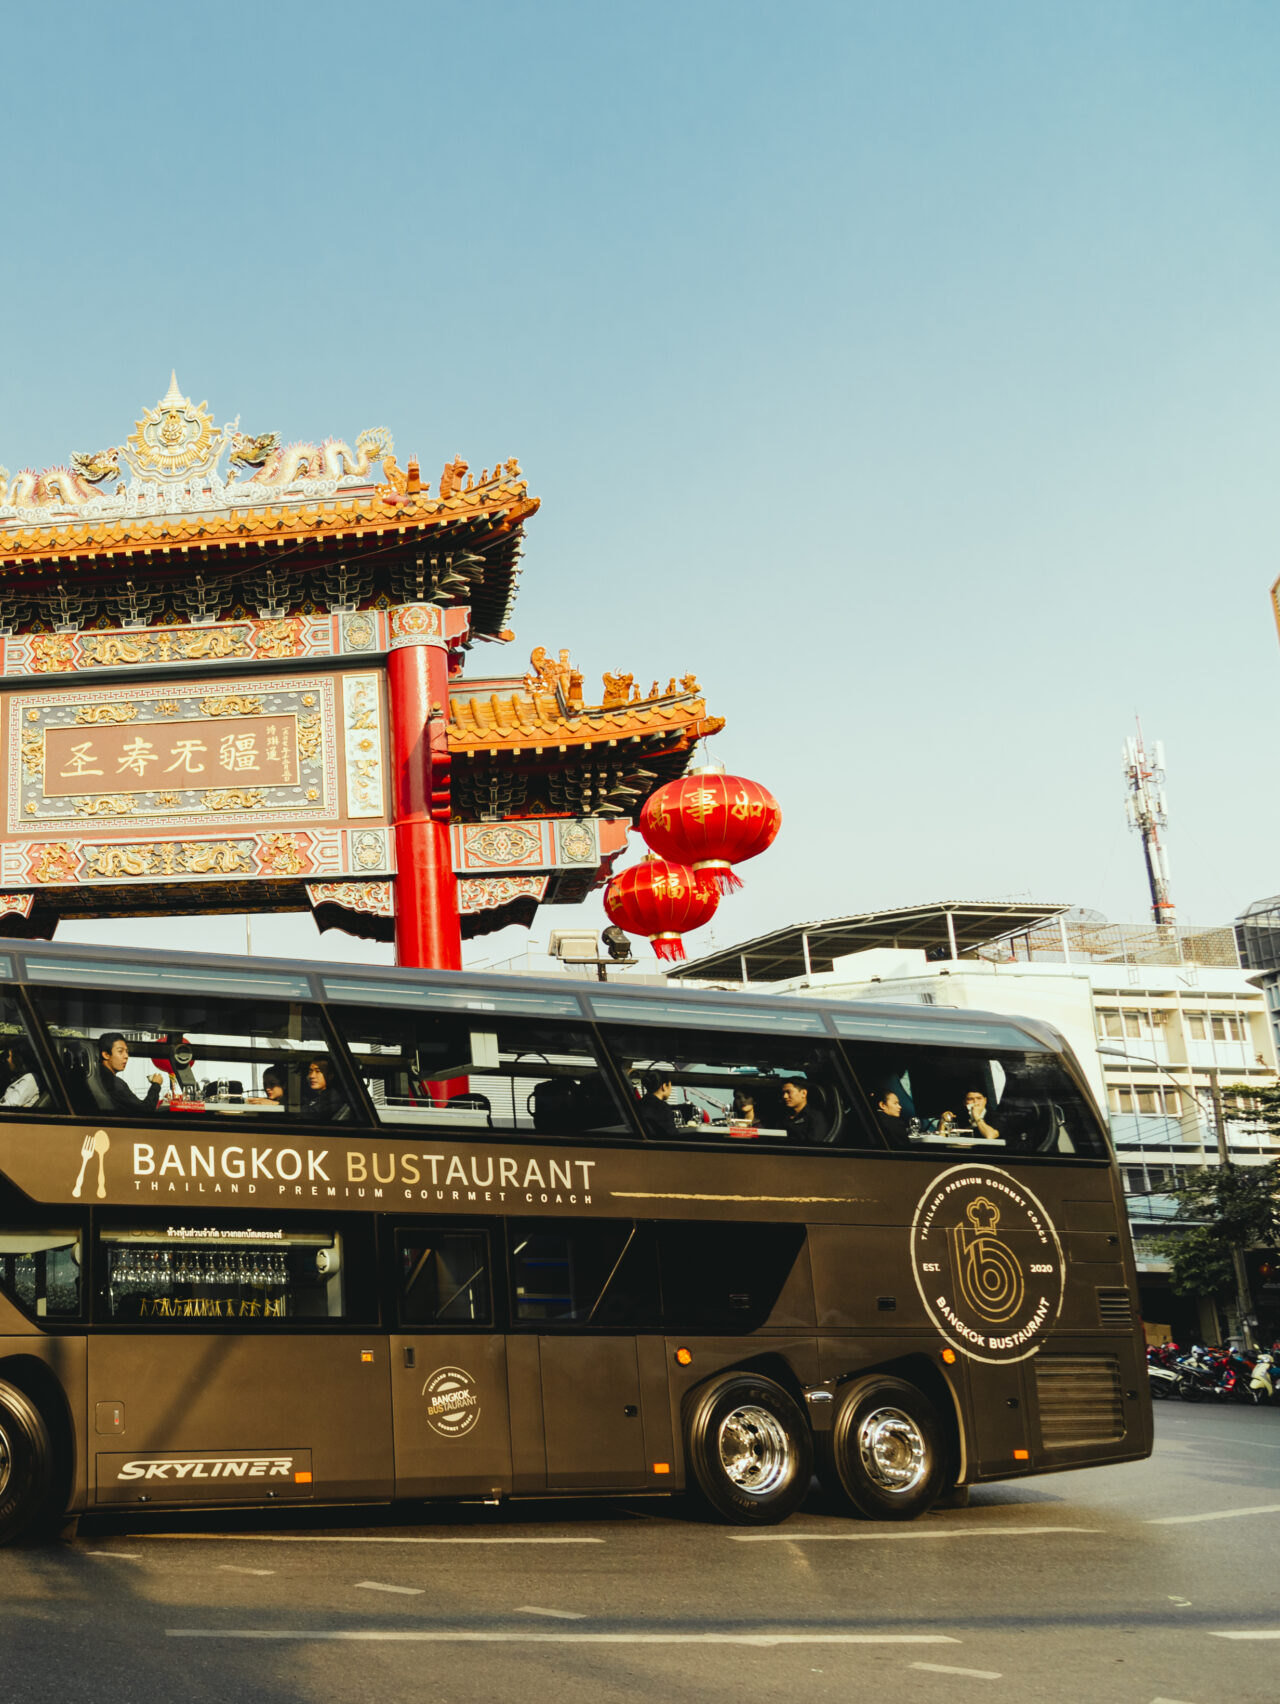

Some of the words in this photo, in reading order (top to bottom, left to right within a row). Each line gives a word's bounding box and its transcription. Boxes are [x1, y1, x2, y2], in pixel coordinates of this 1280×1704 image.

[60, 733, 261, 777] 圣寿无疆
[133, 1143, 331, 1182] BANGKOK
[346, 1151, 596, 1190] BUSTAURANT
[134, 1180, 257, 1194] THAILAND
[278, 1185, 383, 1199] PREMIUM
[404, 1189, 506, 1202] GOURMET
[526, 1193, 593, 1204] COACH
[921, 1192, 945, 1241] THAILAND
[945, 1177, 982, 1194] PREMIUM
[986, 1178, 1026, 1207] GOURMET
[1027, 1210, 1048, 1244] COACH
[922, 1263, 941, 1272] EST.
[1030, 1264, 1054, 1273] 2020
[935, 1296, 986, 1347] BANGKOK
[988, 1296, 1051, 1349] BUSTAURANT
[427, 1395, 477, 1416] BUSTAURANT
[431, 1389, 471, 1407] BANGKOK
[117, 1457, 293, 1480] SKYLINER
